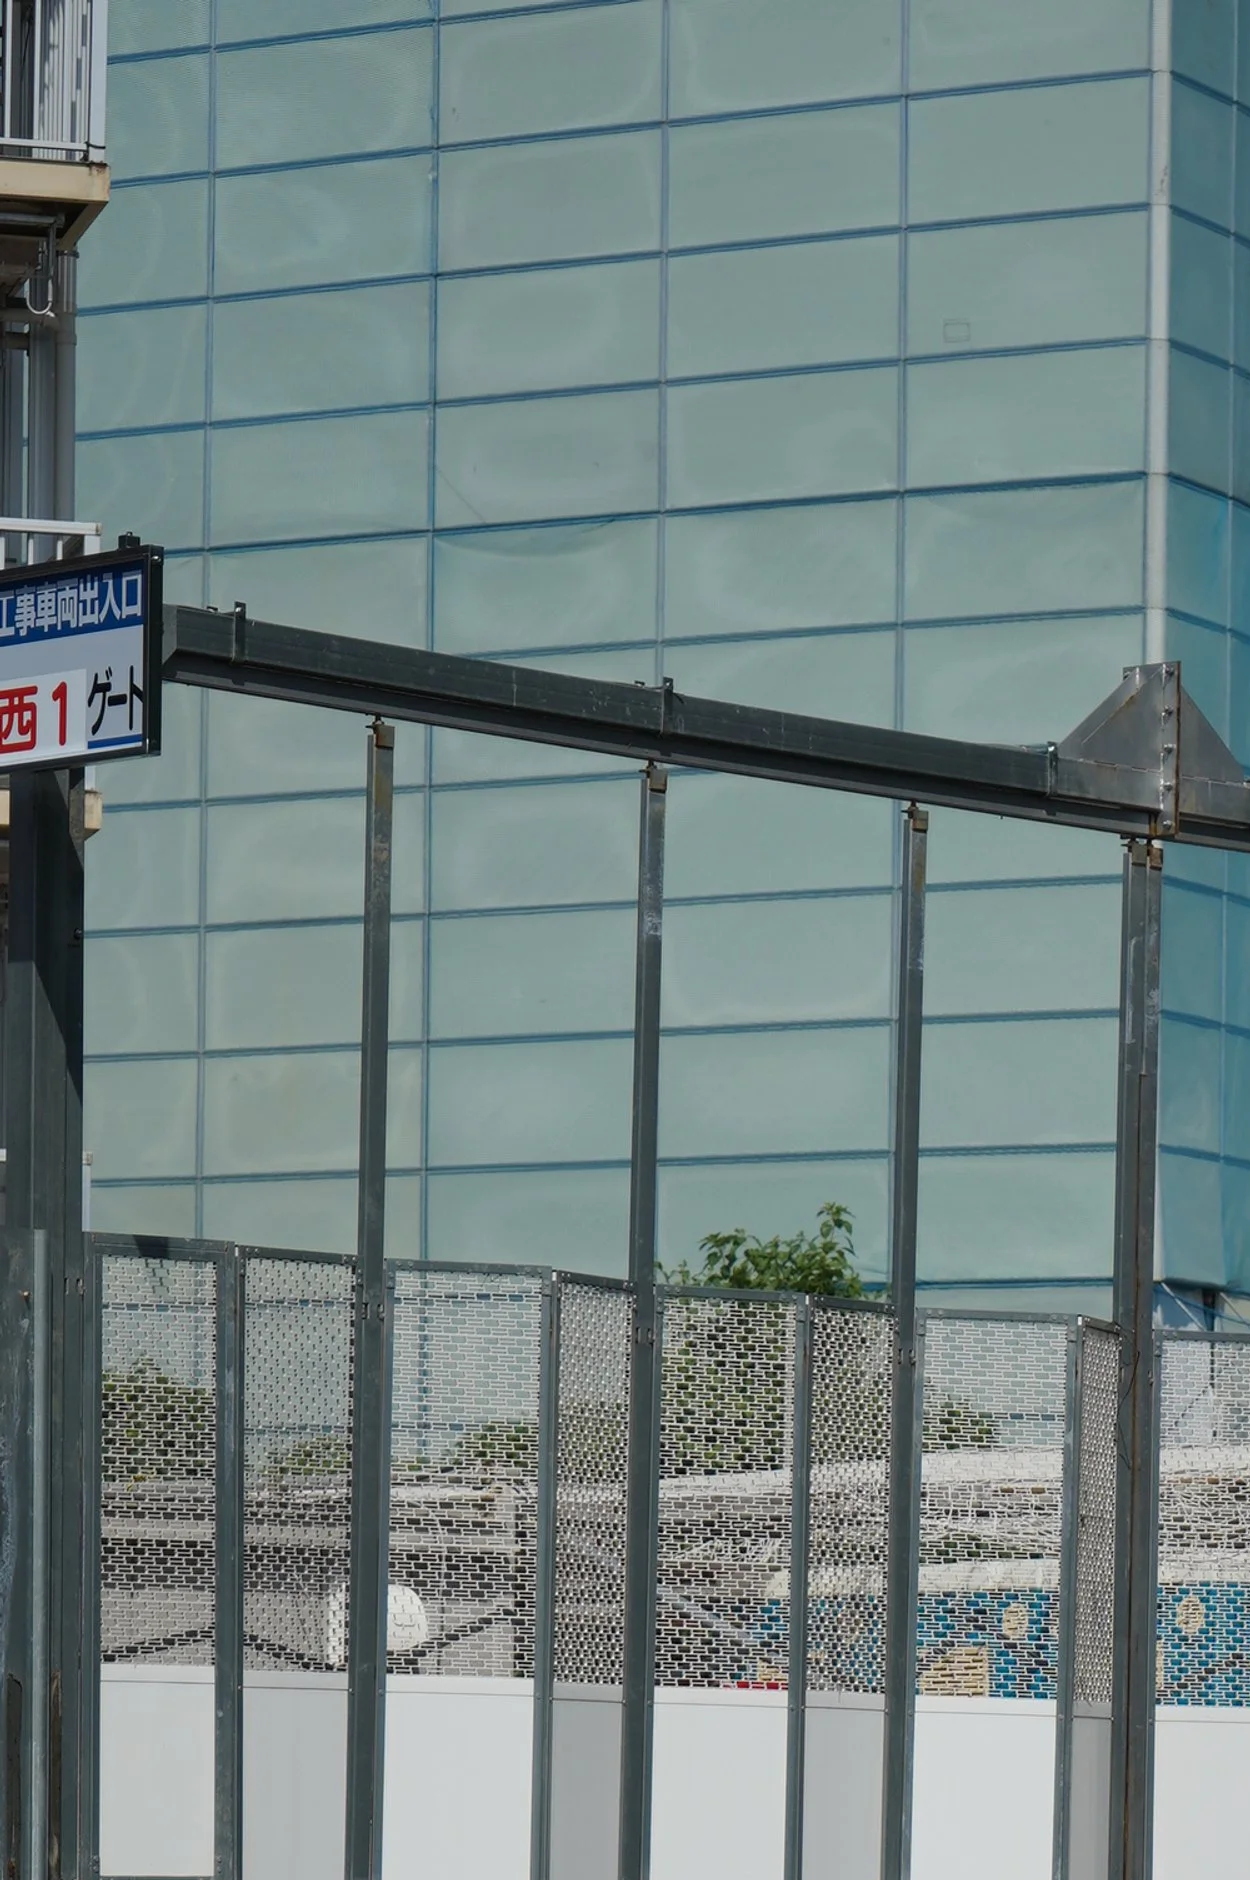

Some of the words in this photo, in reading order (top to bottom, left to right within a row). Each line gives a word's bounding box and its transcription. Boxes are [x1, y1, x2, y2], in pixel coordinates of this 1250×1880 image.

[0, 569, 143, 638] 工事車両出入口
